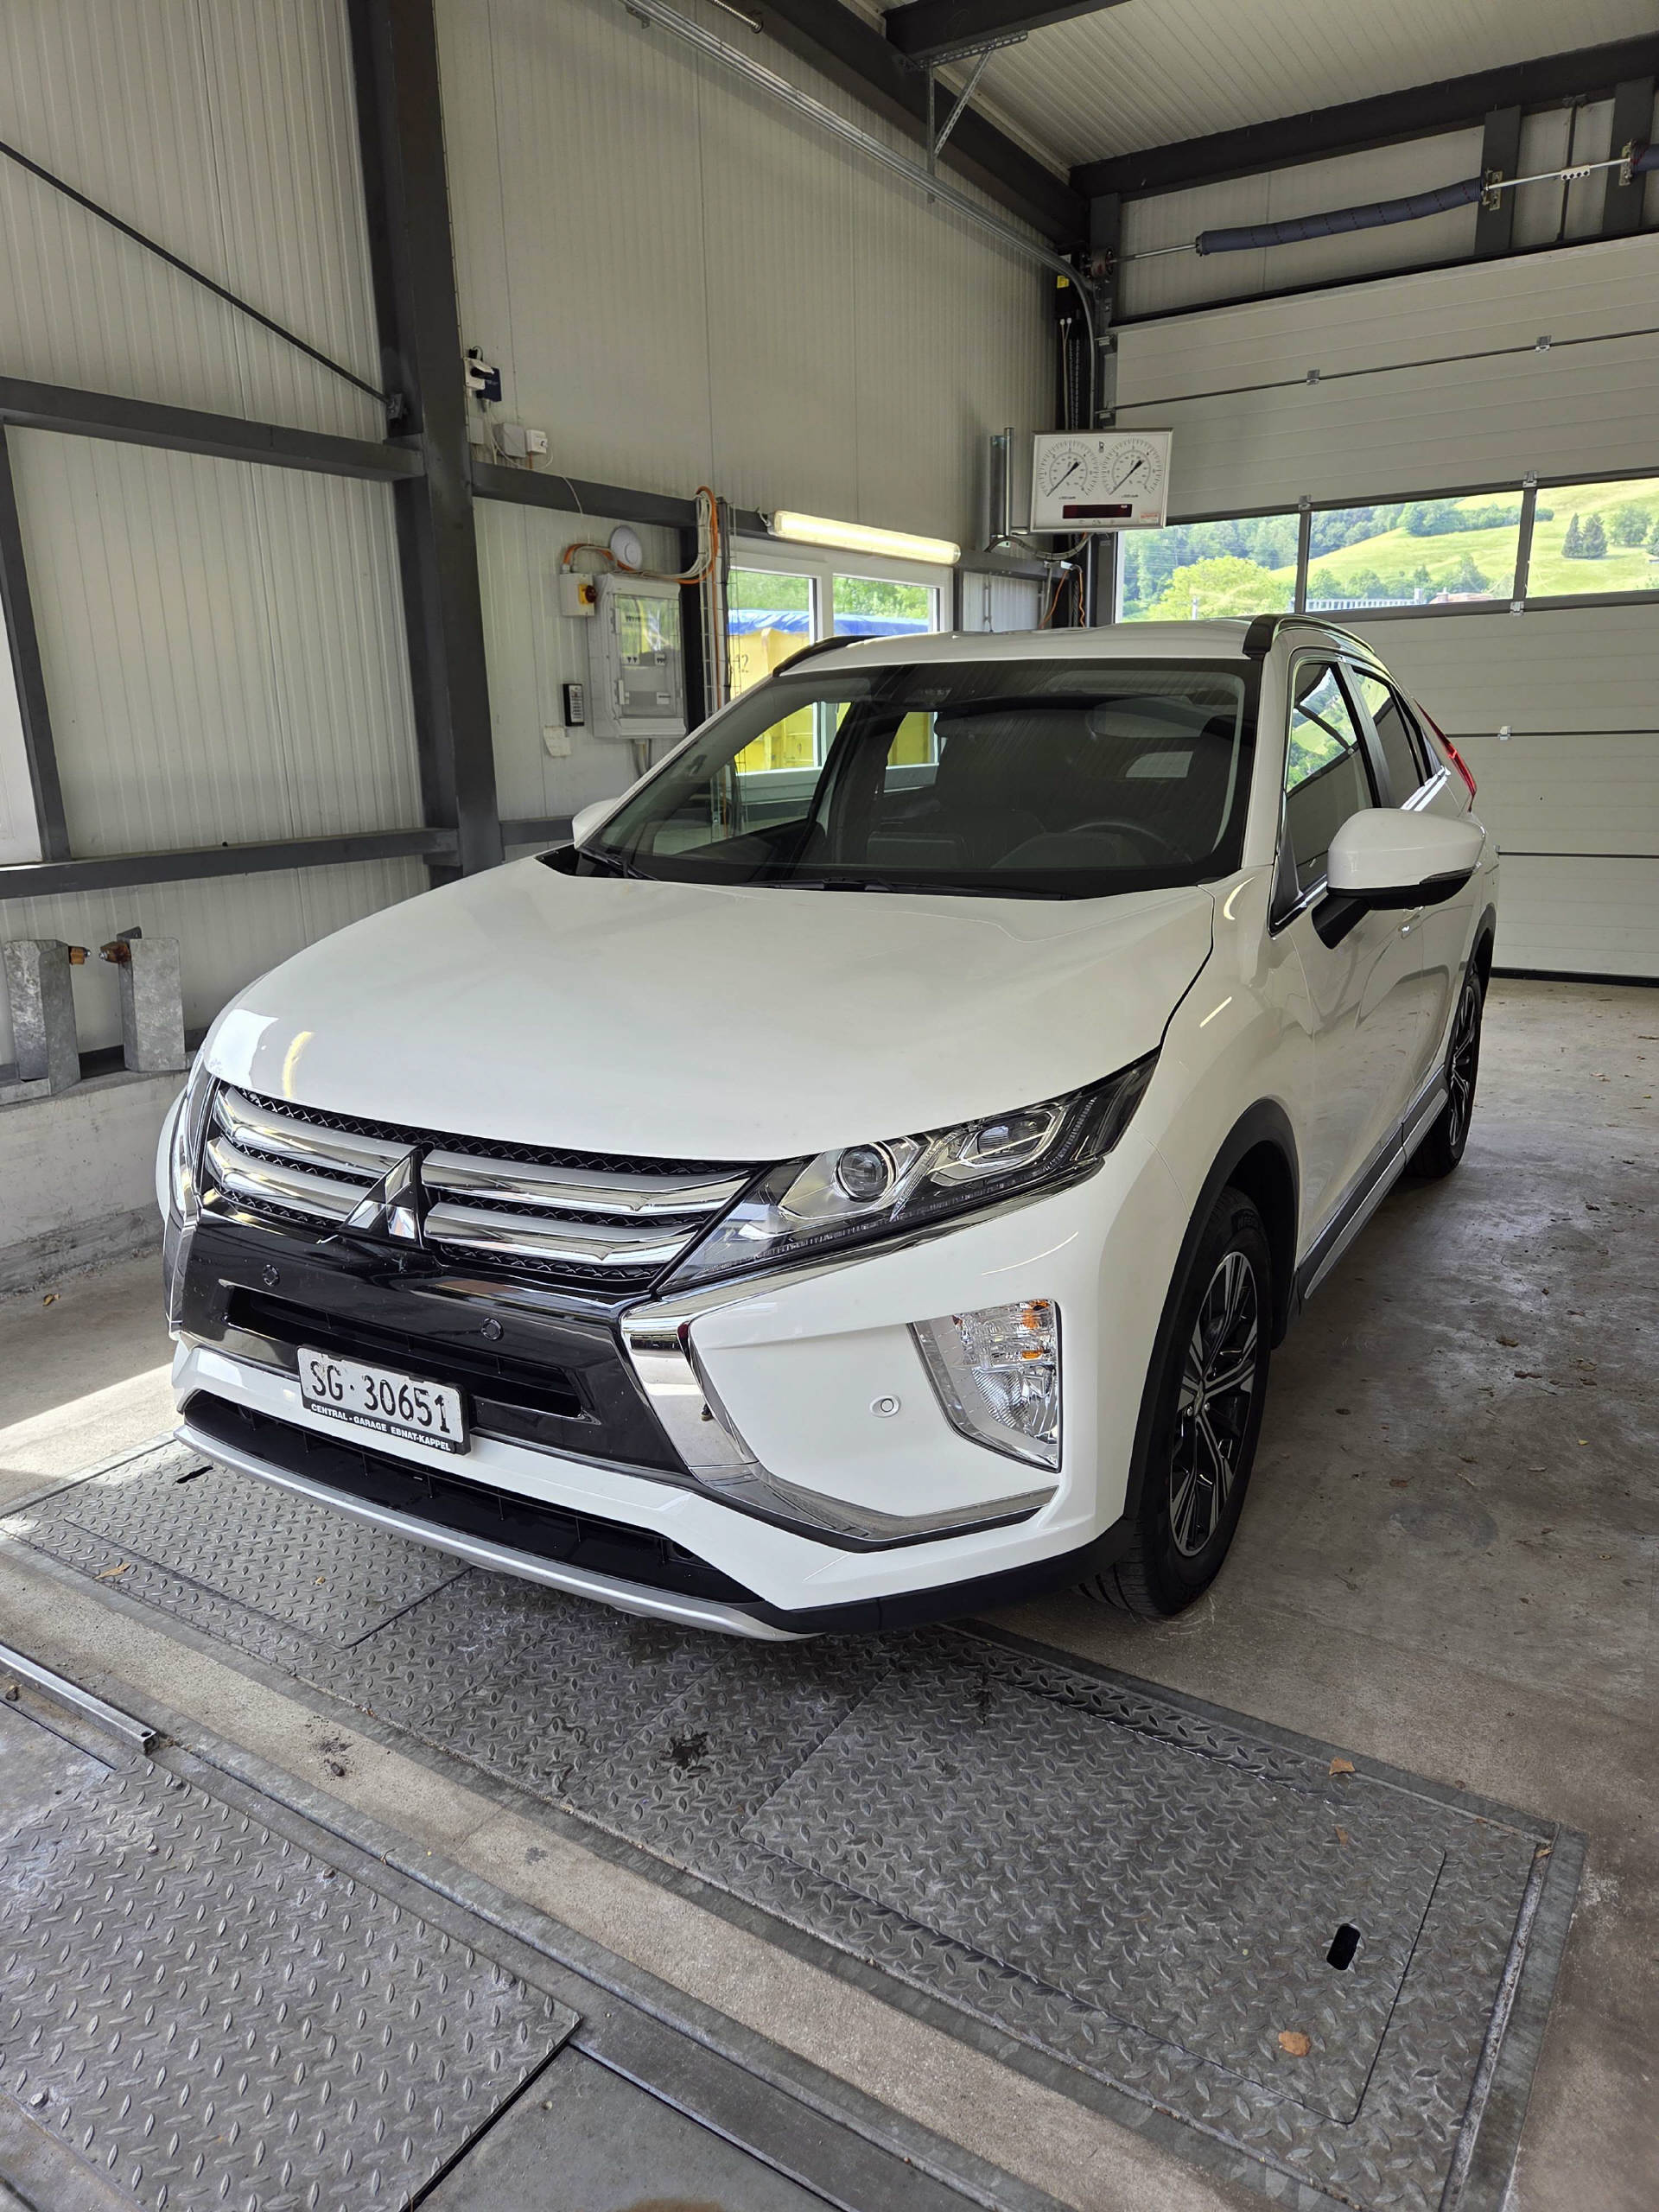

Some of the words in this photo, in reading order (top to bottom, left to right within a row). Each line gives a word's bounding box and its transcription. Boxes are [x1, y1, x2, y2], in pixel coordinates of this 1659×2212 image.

[311, 1403, 348, 1421] CENTRAL
[353, 1415, 388, 1433] GARAGE
[361, 1375, 451, 1434] 30651
